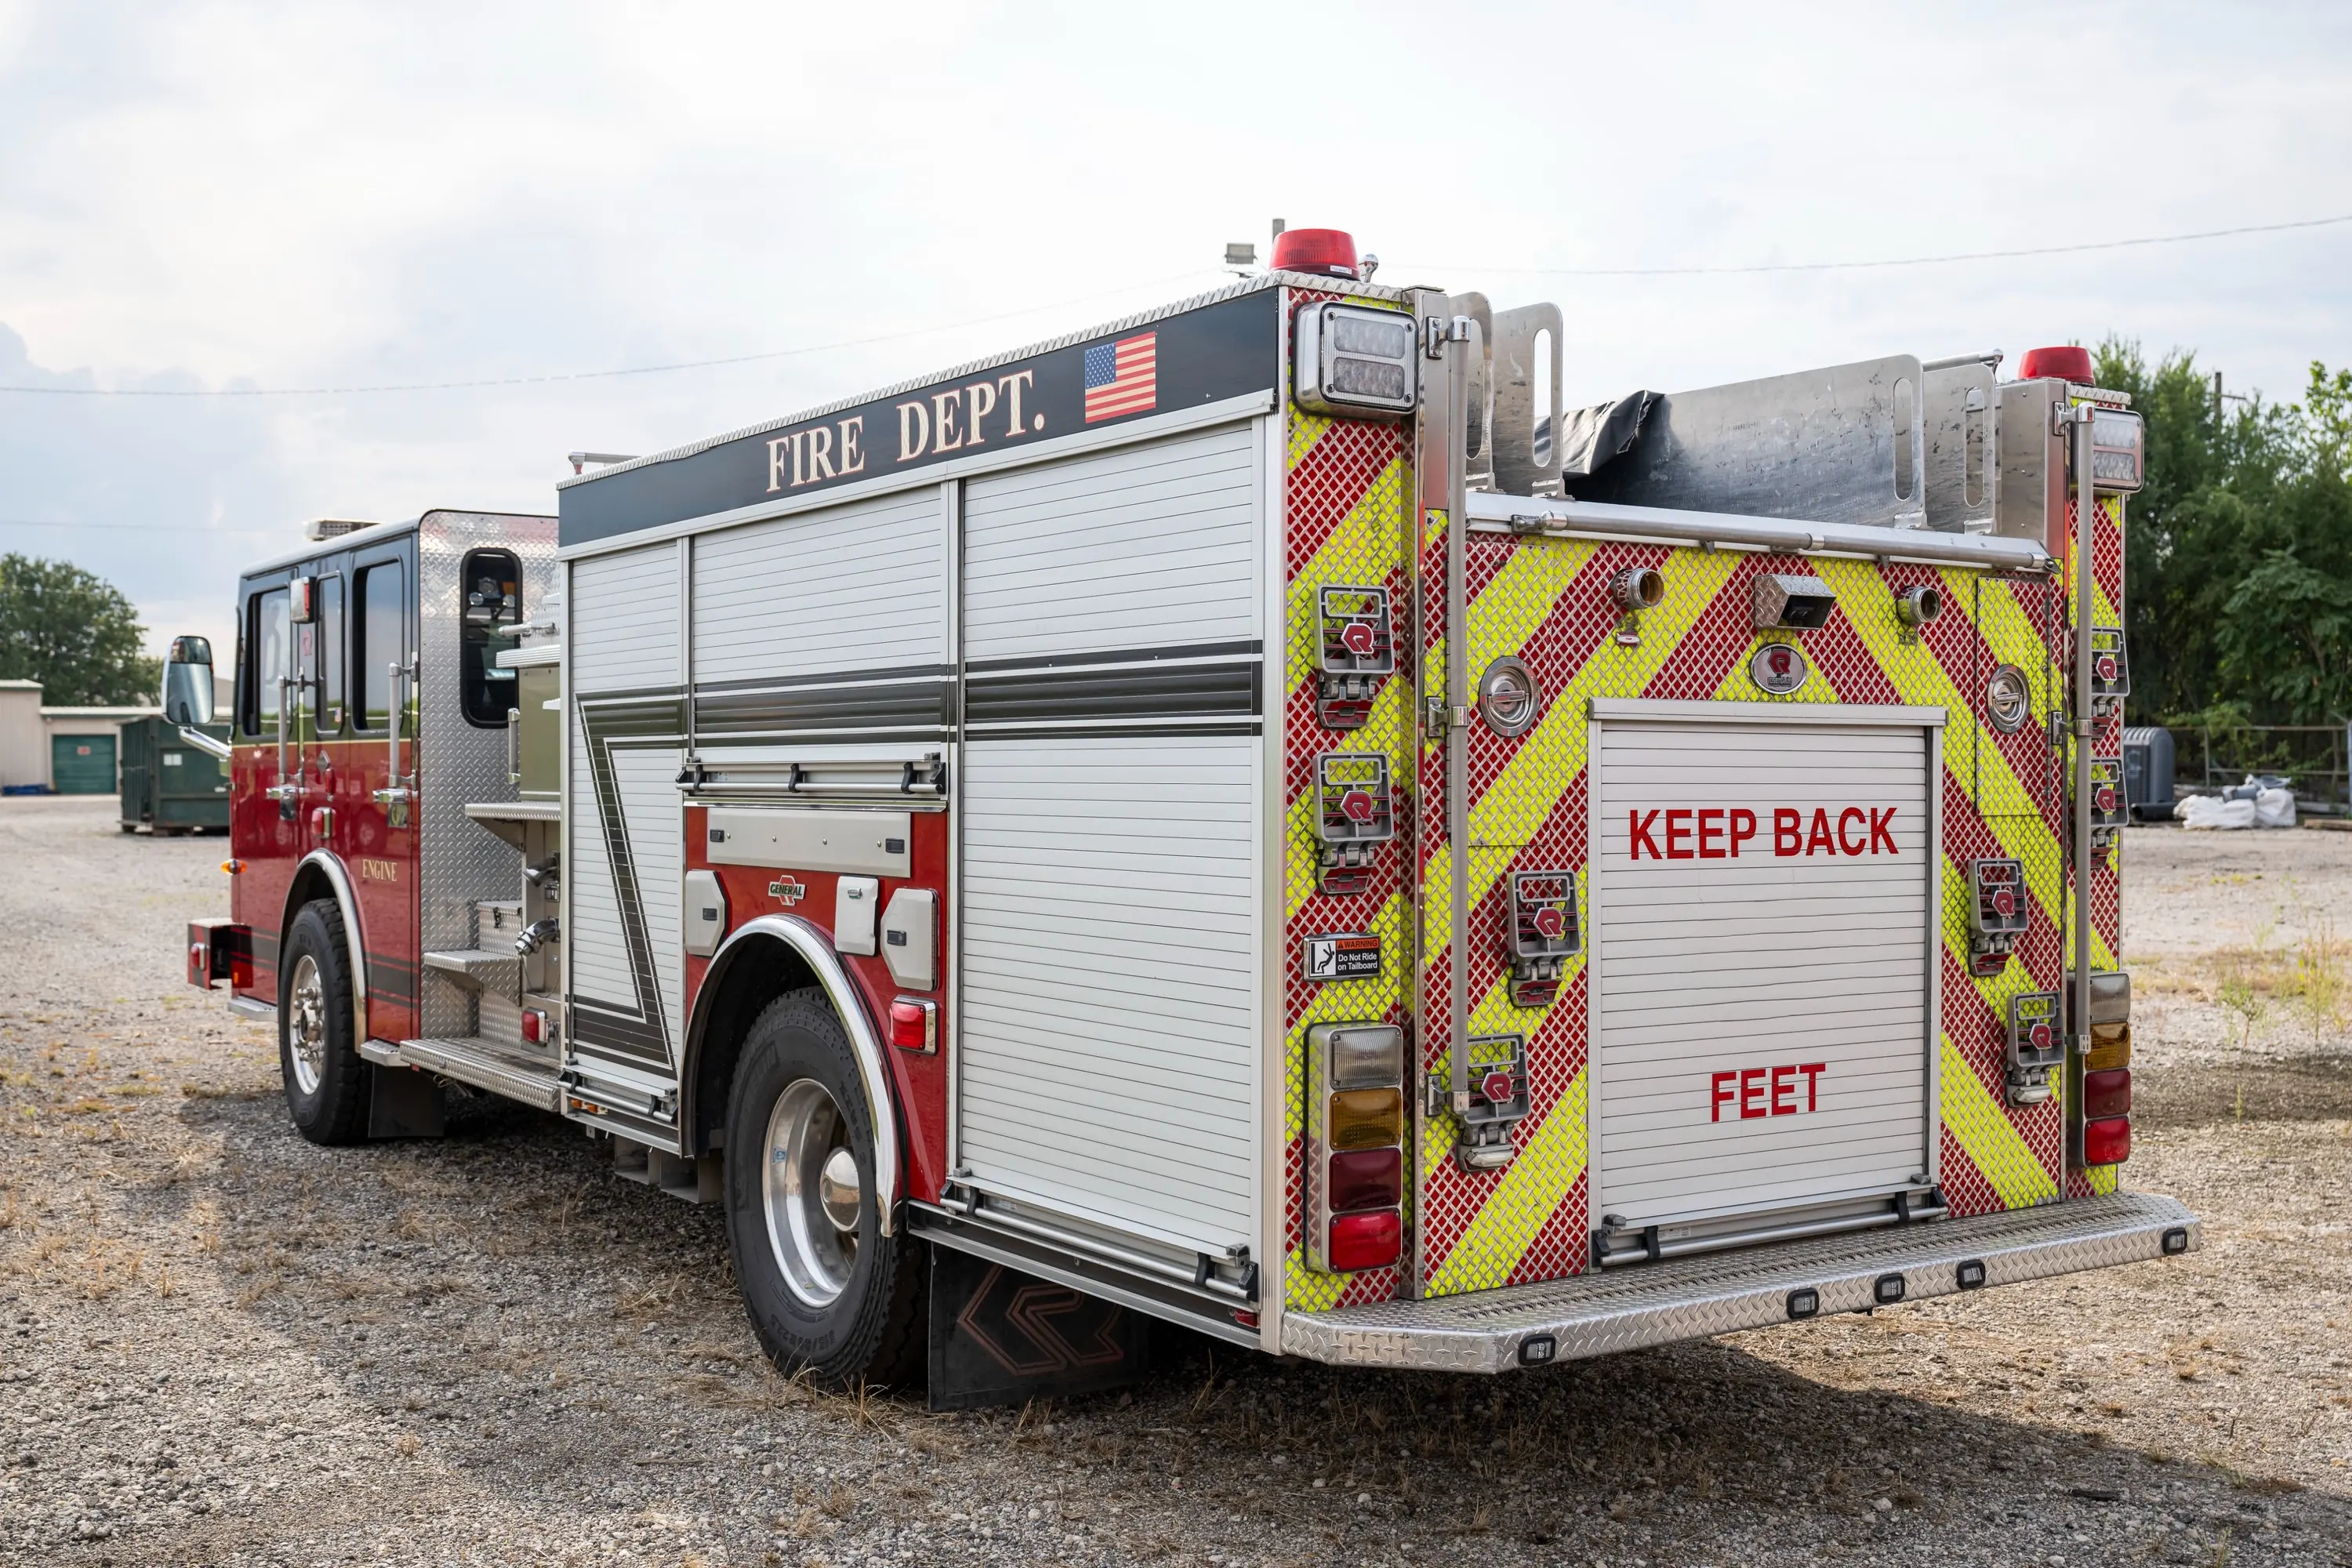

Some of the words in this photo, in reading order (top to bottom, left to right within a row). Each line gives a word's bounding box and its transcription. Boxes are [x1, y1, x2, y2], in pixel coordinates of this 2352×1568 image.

[766, 415, 865, 492] FIRE
[896, 369, 1045, 462] DEPT.
[1630, 809, 1757, 860] KEEP
[1774, 807, 1899, 857] BACK
[362, 858, 397, 882] ENGINE
[770, 884, 803, 896] GENERAL
[1344, 939, 1377, 948] WARNING
[1349, 953, 1361, 961] Not
[1363, 952, 1377, 960] Ride
[1348, 961, 1377, 971] Tailboard
[1711, 1063, 1826, 1123] FEET
